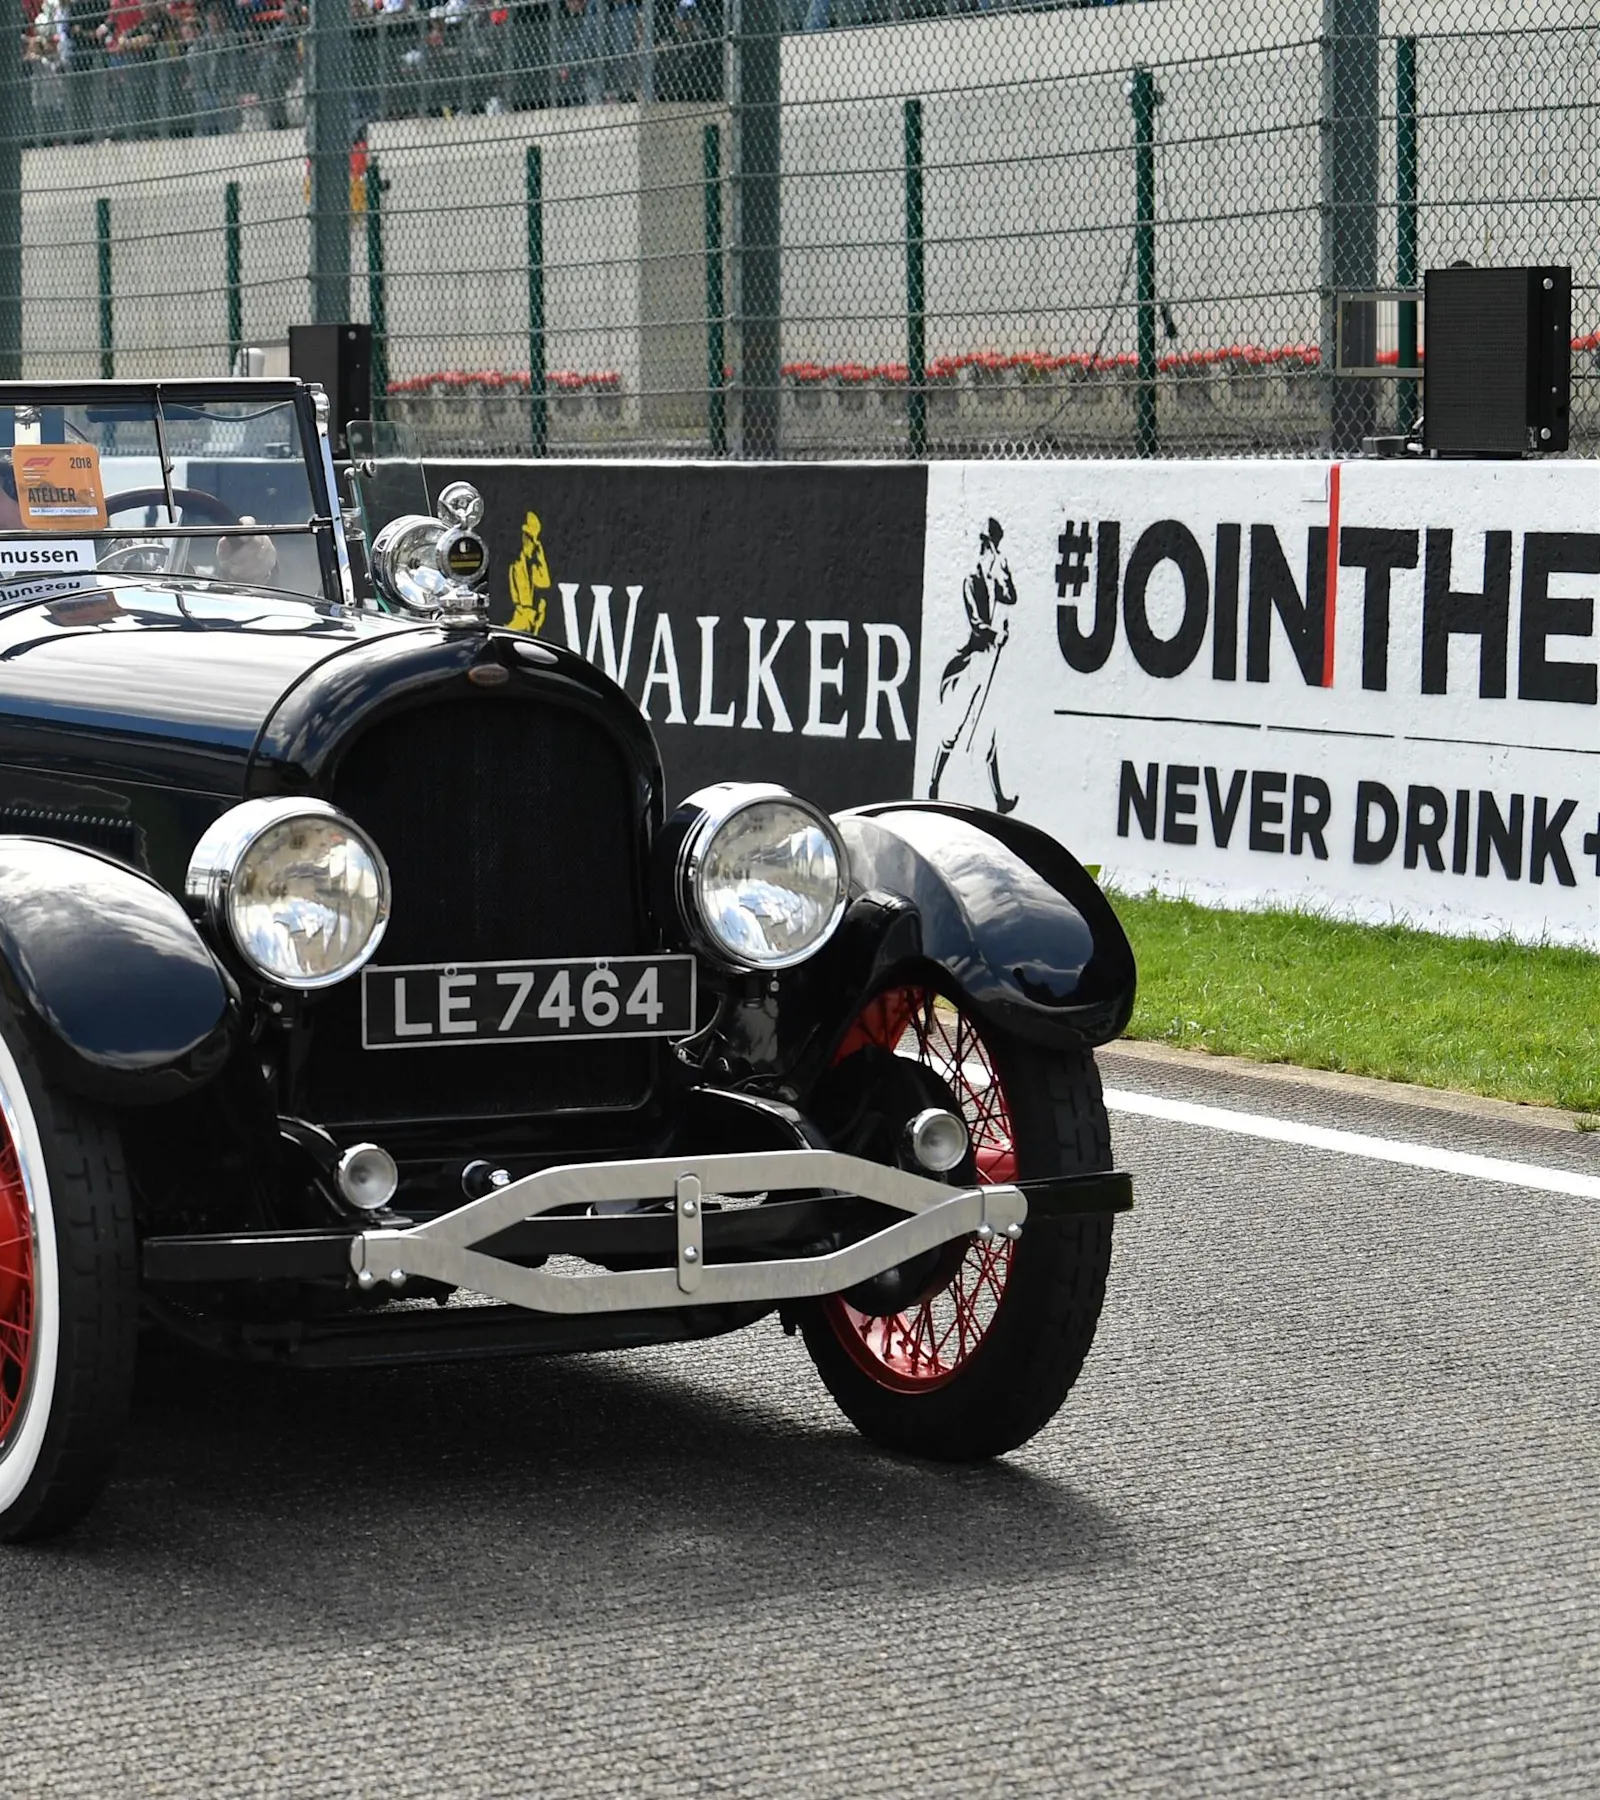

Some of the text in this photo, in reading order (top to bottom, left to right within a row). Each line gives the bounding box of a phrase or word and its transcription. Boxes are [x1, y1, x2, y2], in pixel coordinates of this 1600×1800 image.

[28, 487, 77, 503] ATELIER
[69, 457, 92, 469] 2018
[1055, 519, 1600, 704] #JOINTHE
[557, 582, 912, 742] WALKER
[1116, 759, 1332, 861] NEVER
[395, 966, 664, 1036] LE 7464
